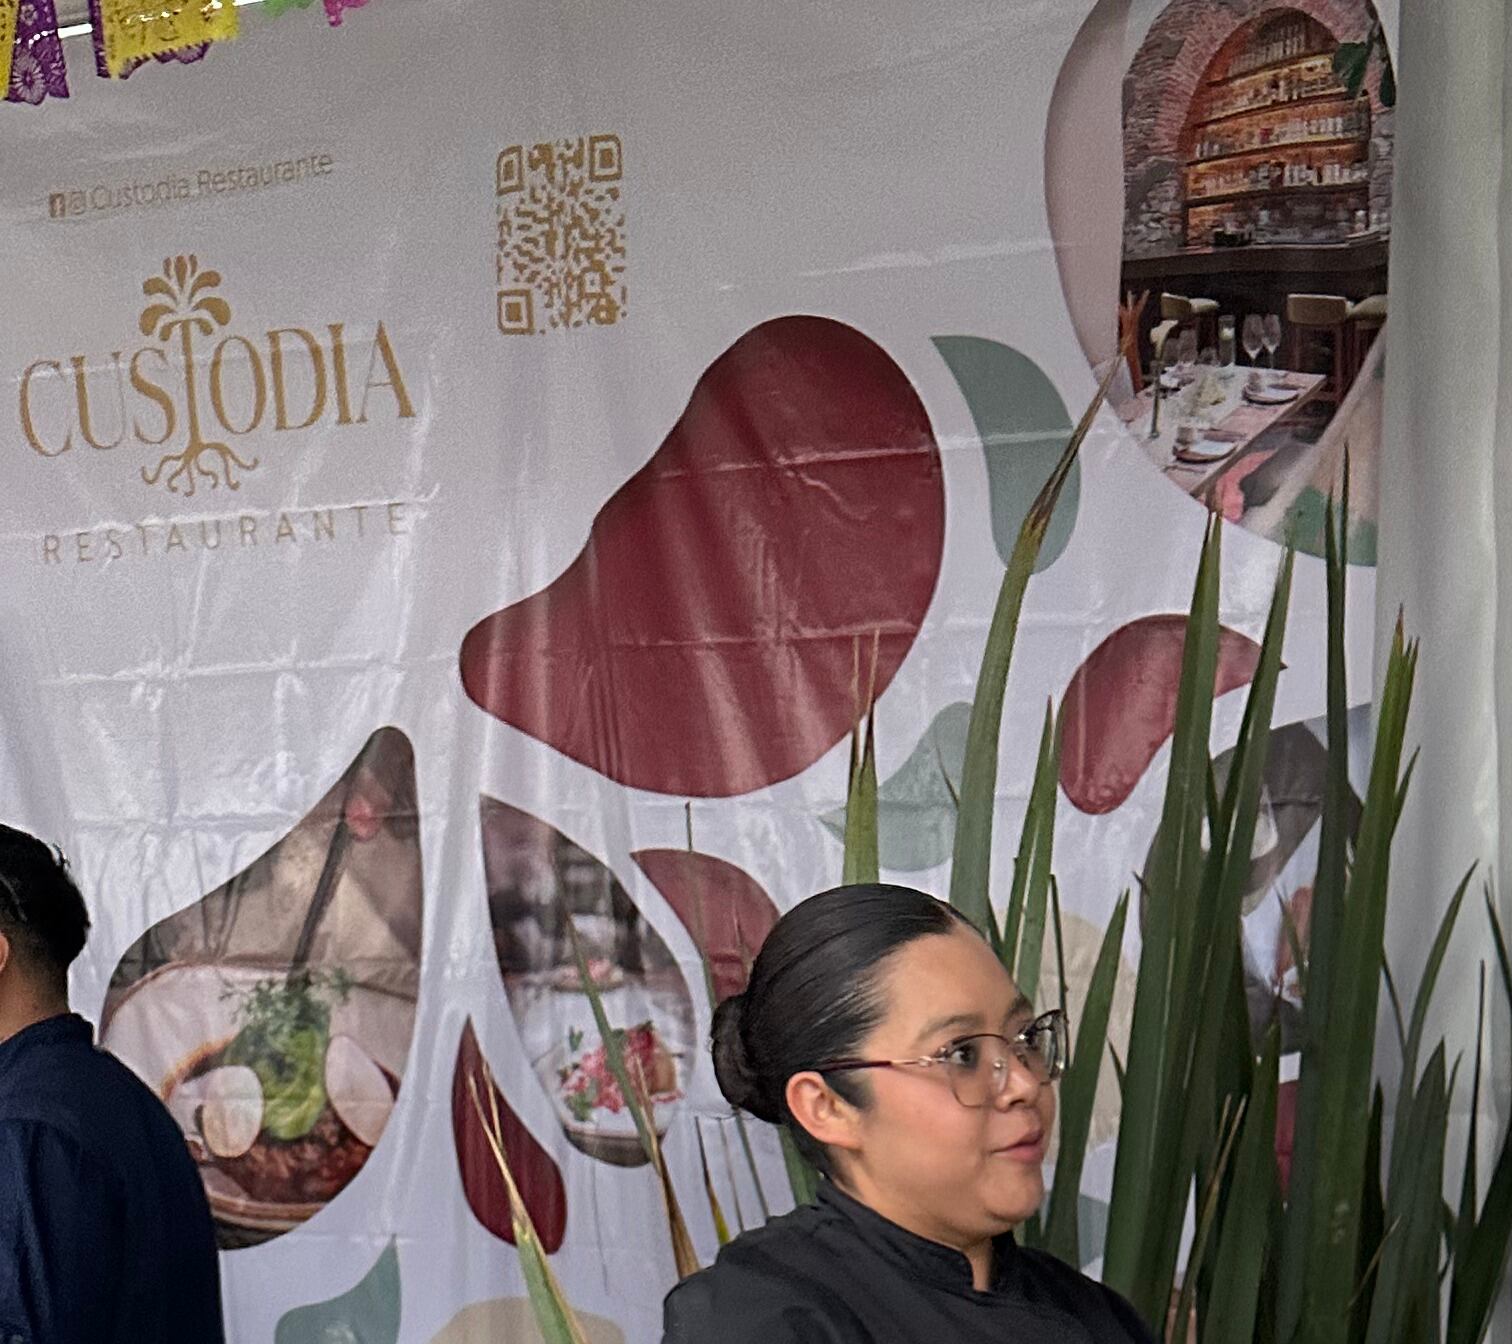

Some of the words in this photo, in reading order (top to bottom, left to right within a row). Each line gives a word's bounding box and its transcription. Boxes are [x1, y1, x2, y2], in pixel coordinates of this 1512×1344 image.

[198, 153, 333, 194] Restaurante
[18, 318, 417, 459] CUSTODIA
[42, 502, 409, 566] RESTAURANTE
